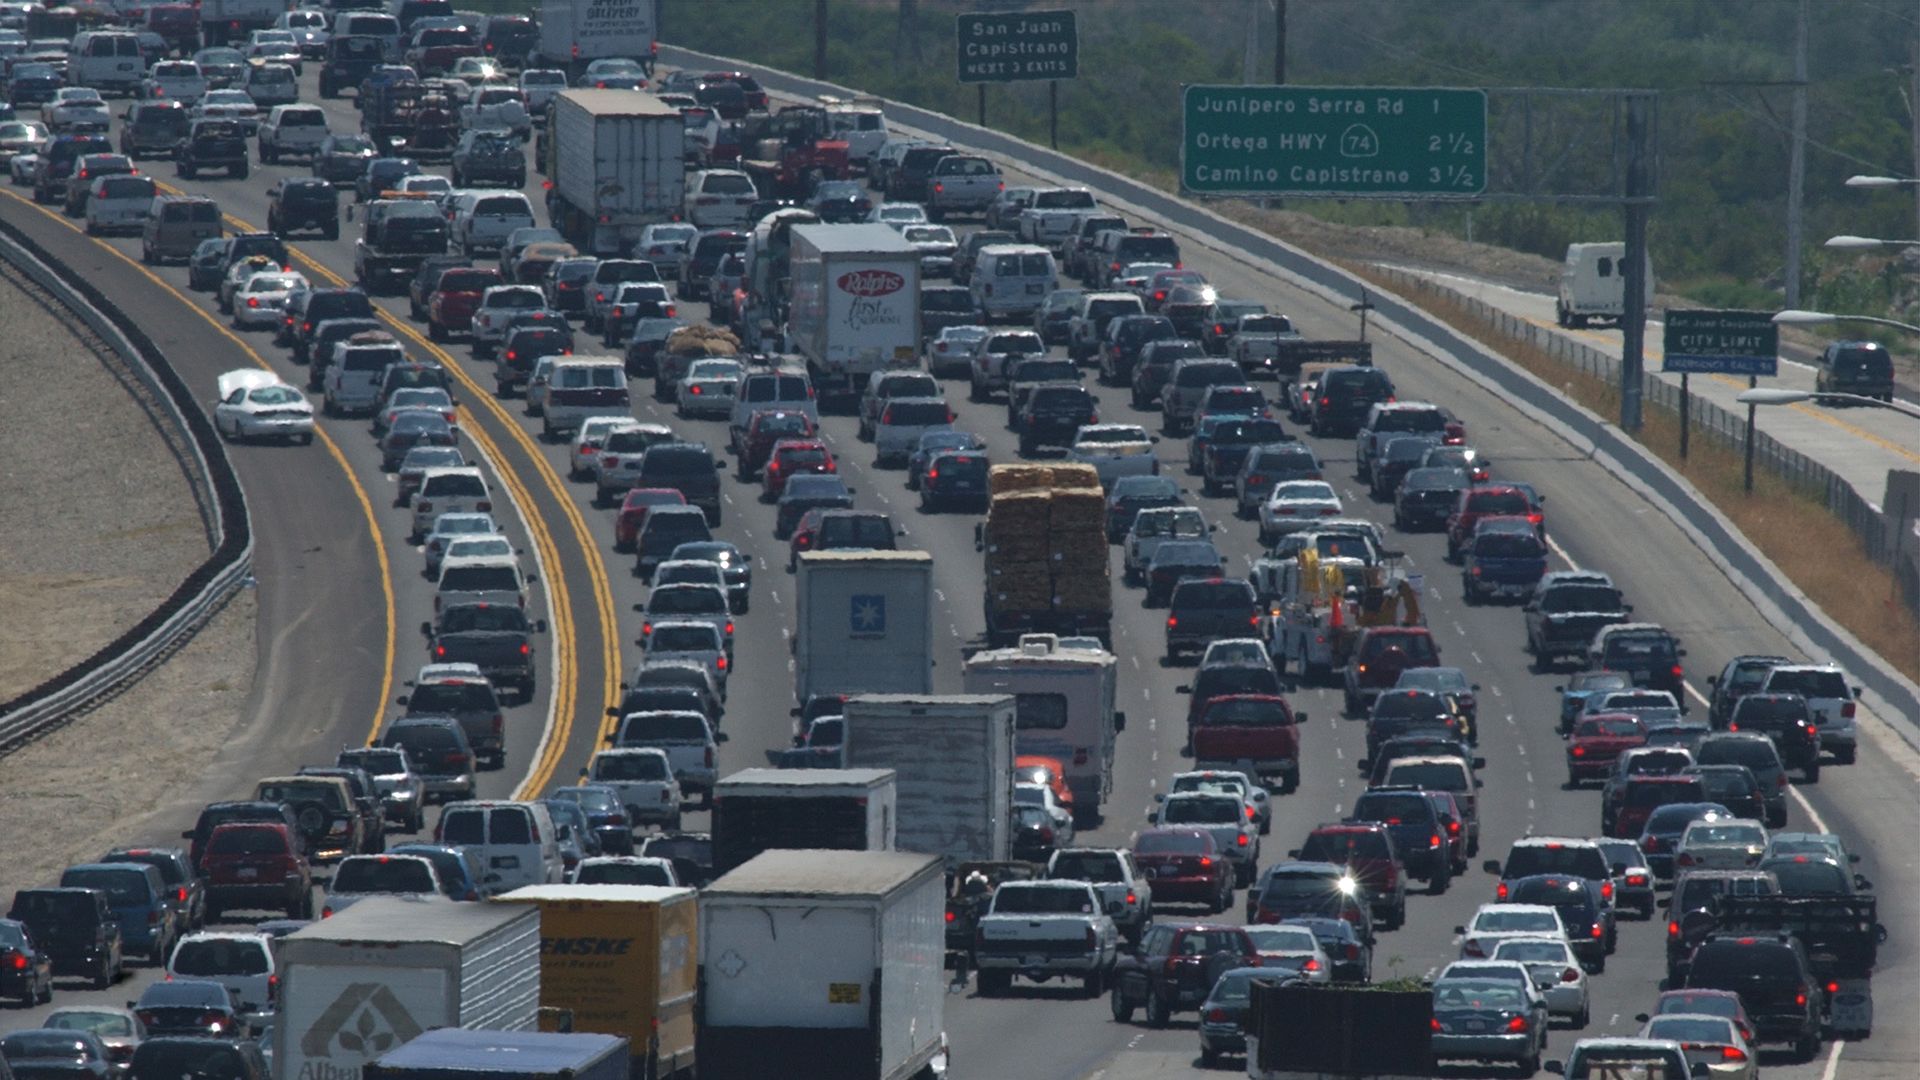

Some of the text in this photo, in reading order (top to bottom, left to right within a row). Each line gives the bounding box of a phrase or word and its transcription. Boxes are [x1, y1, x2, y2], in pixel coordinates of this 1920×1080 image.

[586, 7, 640, 19] DELIVERY
[973, 20, 1062, 36] San Juan
[966, 41, 1069, 57] Capistrano
[967, 60, 1067, 74] NEXT 3 EXITS
[1197, 96, 1440, 116] Junipero Serra Rd 1
[1196, 132, 1268, 153] Ortega
[1280, 133, 1327, 150] HWY
[1348, 135, 1371, 150] 74
[1428, 135, 1441, 151] 2
[1195, 165, 1279, 182] Camino
[1290, 165, 1410, 184] Capistrano
[1428, 167, 1441, 183] 3
[844, 272, 902, 296] Ralphs
[1680, 335, 1762, 348] CITY LIMIT
[540, 936, 635, 955] ENSKE
